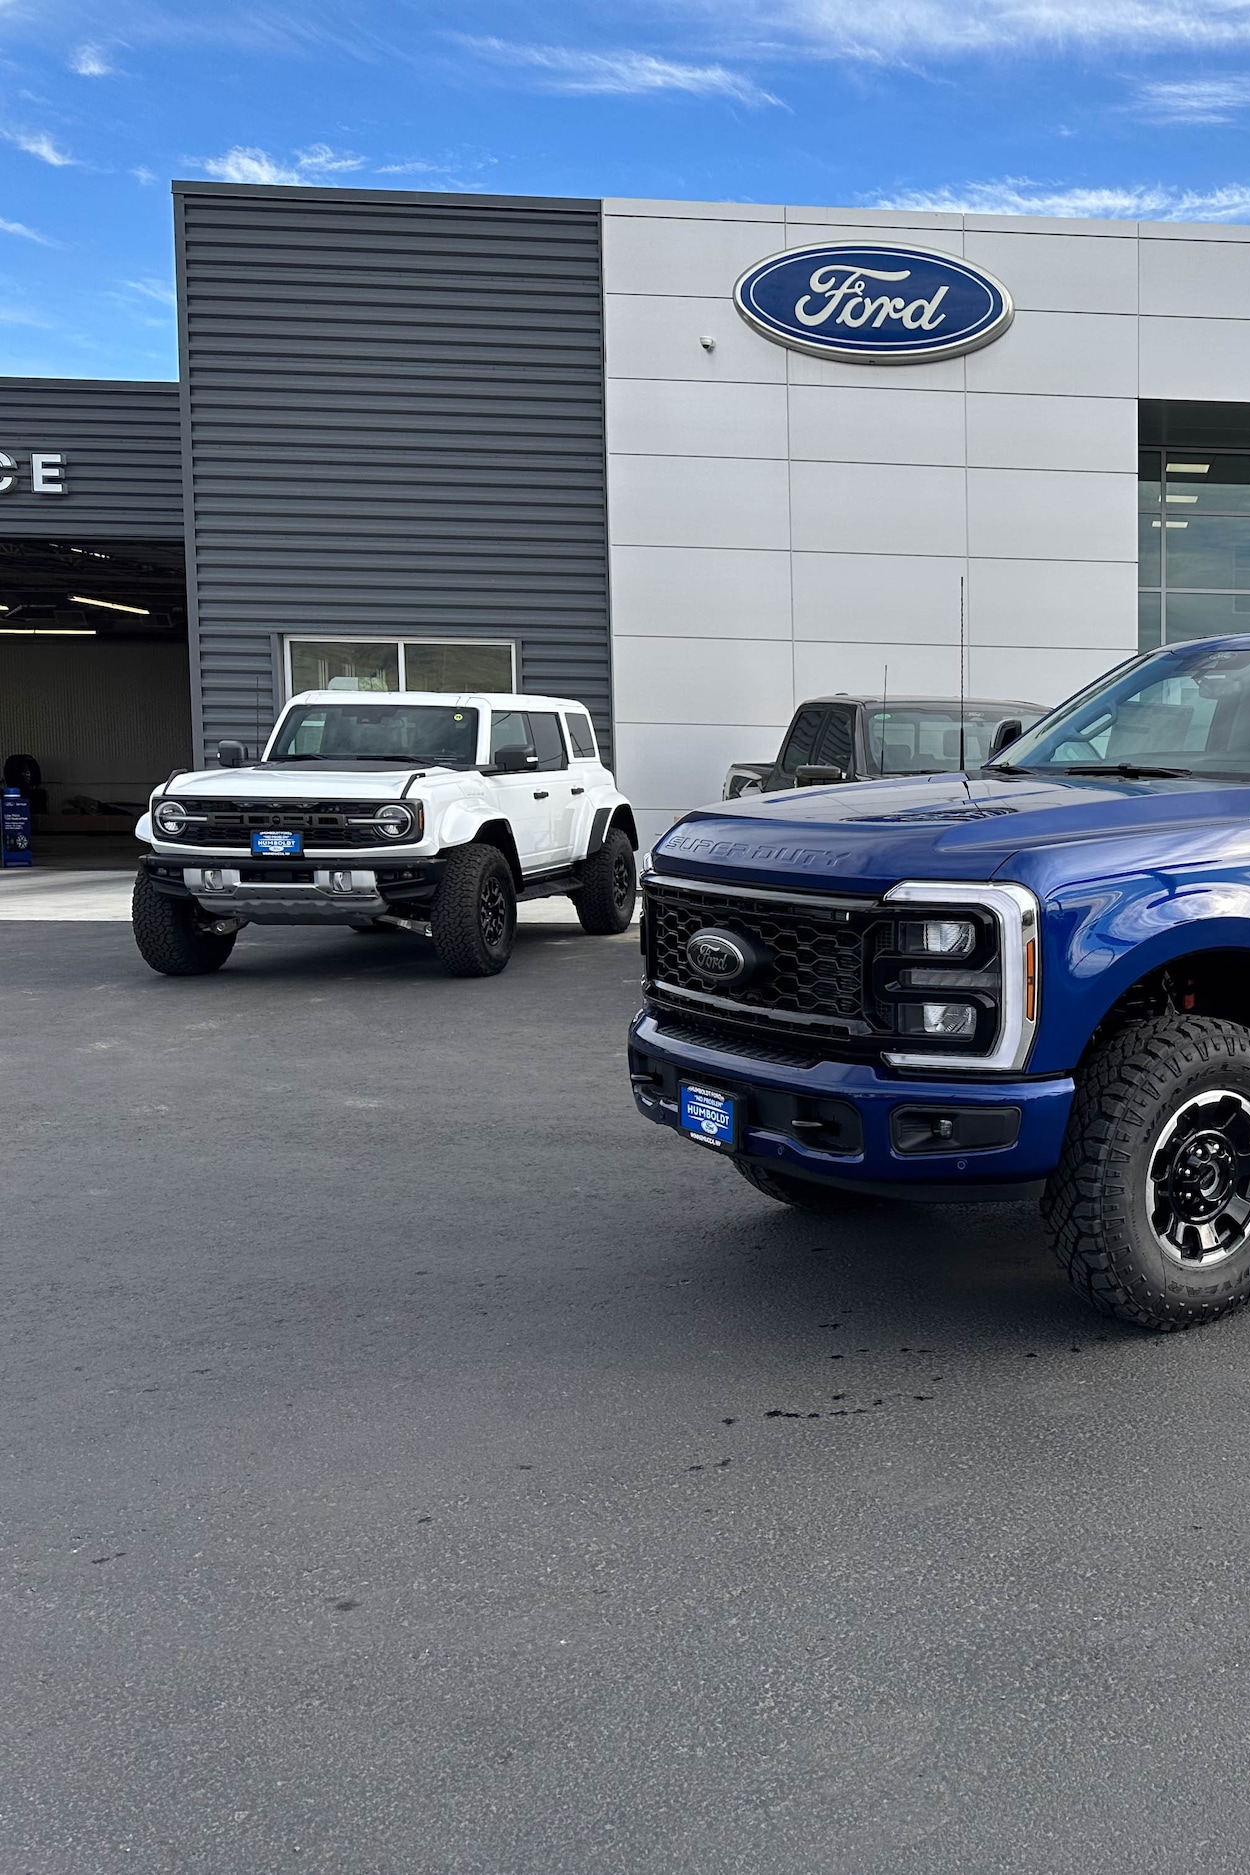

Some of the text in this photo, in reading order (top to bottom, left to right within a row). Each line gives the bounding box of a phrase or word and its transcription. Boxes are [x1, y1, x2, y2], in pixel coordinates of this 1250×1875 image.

[794, 264, 949, 330] Ford
[665, 835, 852, 867] SUPER DUTY
[697, 943, 728, 971] Ford
[687, 1104, 729, 1125] HUMBOLDT
